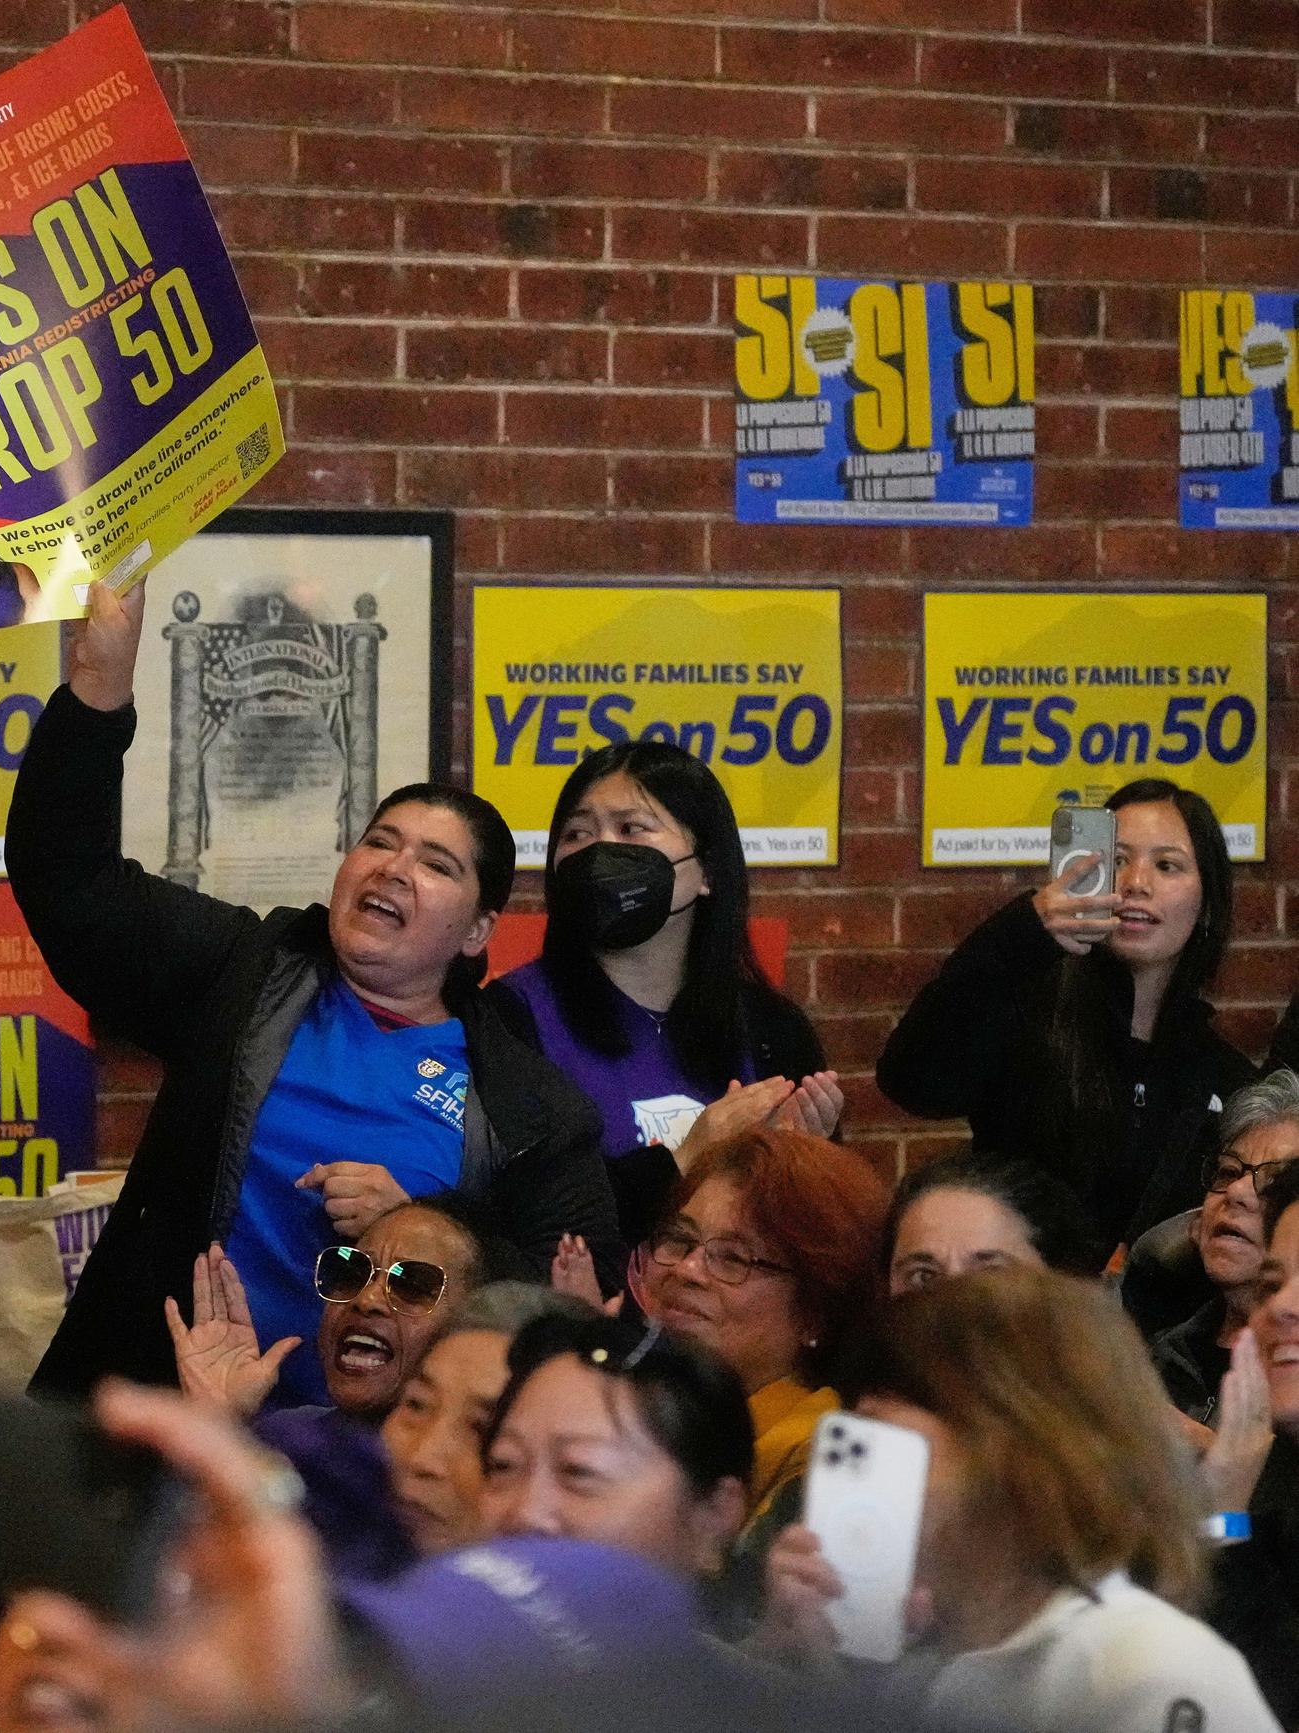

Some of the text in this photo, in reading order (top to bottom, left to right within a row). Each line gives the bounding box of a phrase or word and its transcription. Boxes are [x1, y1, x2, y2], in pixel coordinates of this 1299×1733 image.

[18, 108, 79, 160] RISING
[74, 70, 140, 118] COSTS,
[12, 173, 32, 198] &
[30, 157, 62, 191] ICE
[59, 124, 114, 173] RAIDS
[33, 167, 153, 309] ON
[34, 267, 157, 349] REDISTRICTING
[108, 267, 213, 406] 50
[32, 516, 76, 536] have
[96, 477, 134, 510] draw
[134, 457, 157, 484] the
[157, 439, 183, 466] line
[184, 372, 266, 443] somewhere.
[10, 544, 24, 558] It
[87, 517, 106, 538] be
[108, 497, 138, 521] here
[138, 483, 154, 499] in
[102, 454, 231, 564] Working Party Director
[103, 520, 130, 547] Kim
[504, 662, 804, 684] WORKING FAMILIES SAY
[955, 666, 1232, 687] WORKING FAMILIES SAY
[485, 693, 833, 767] YES 50
[935, 694, 1258, 766] YES on 50
[935, 838, 1010, 853] Ad paid by
[0, 968, 44, 997] RAIDS
